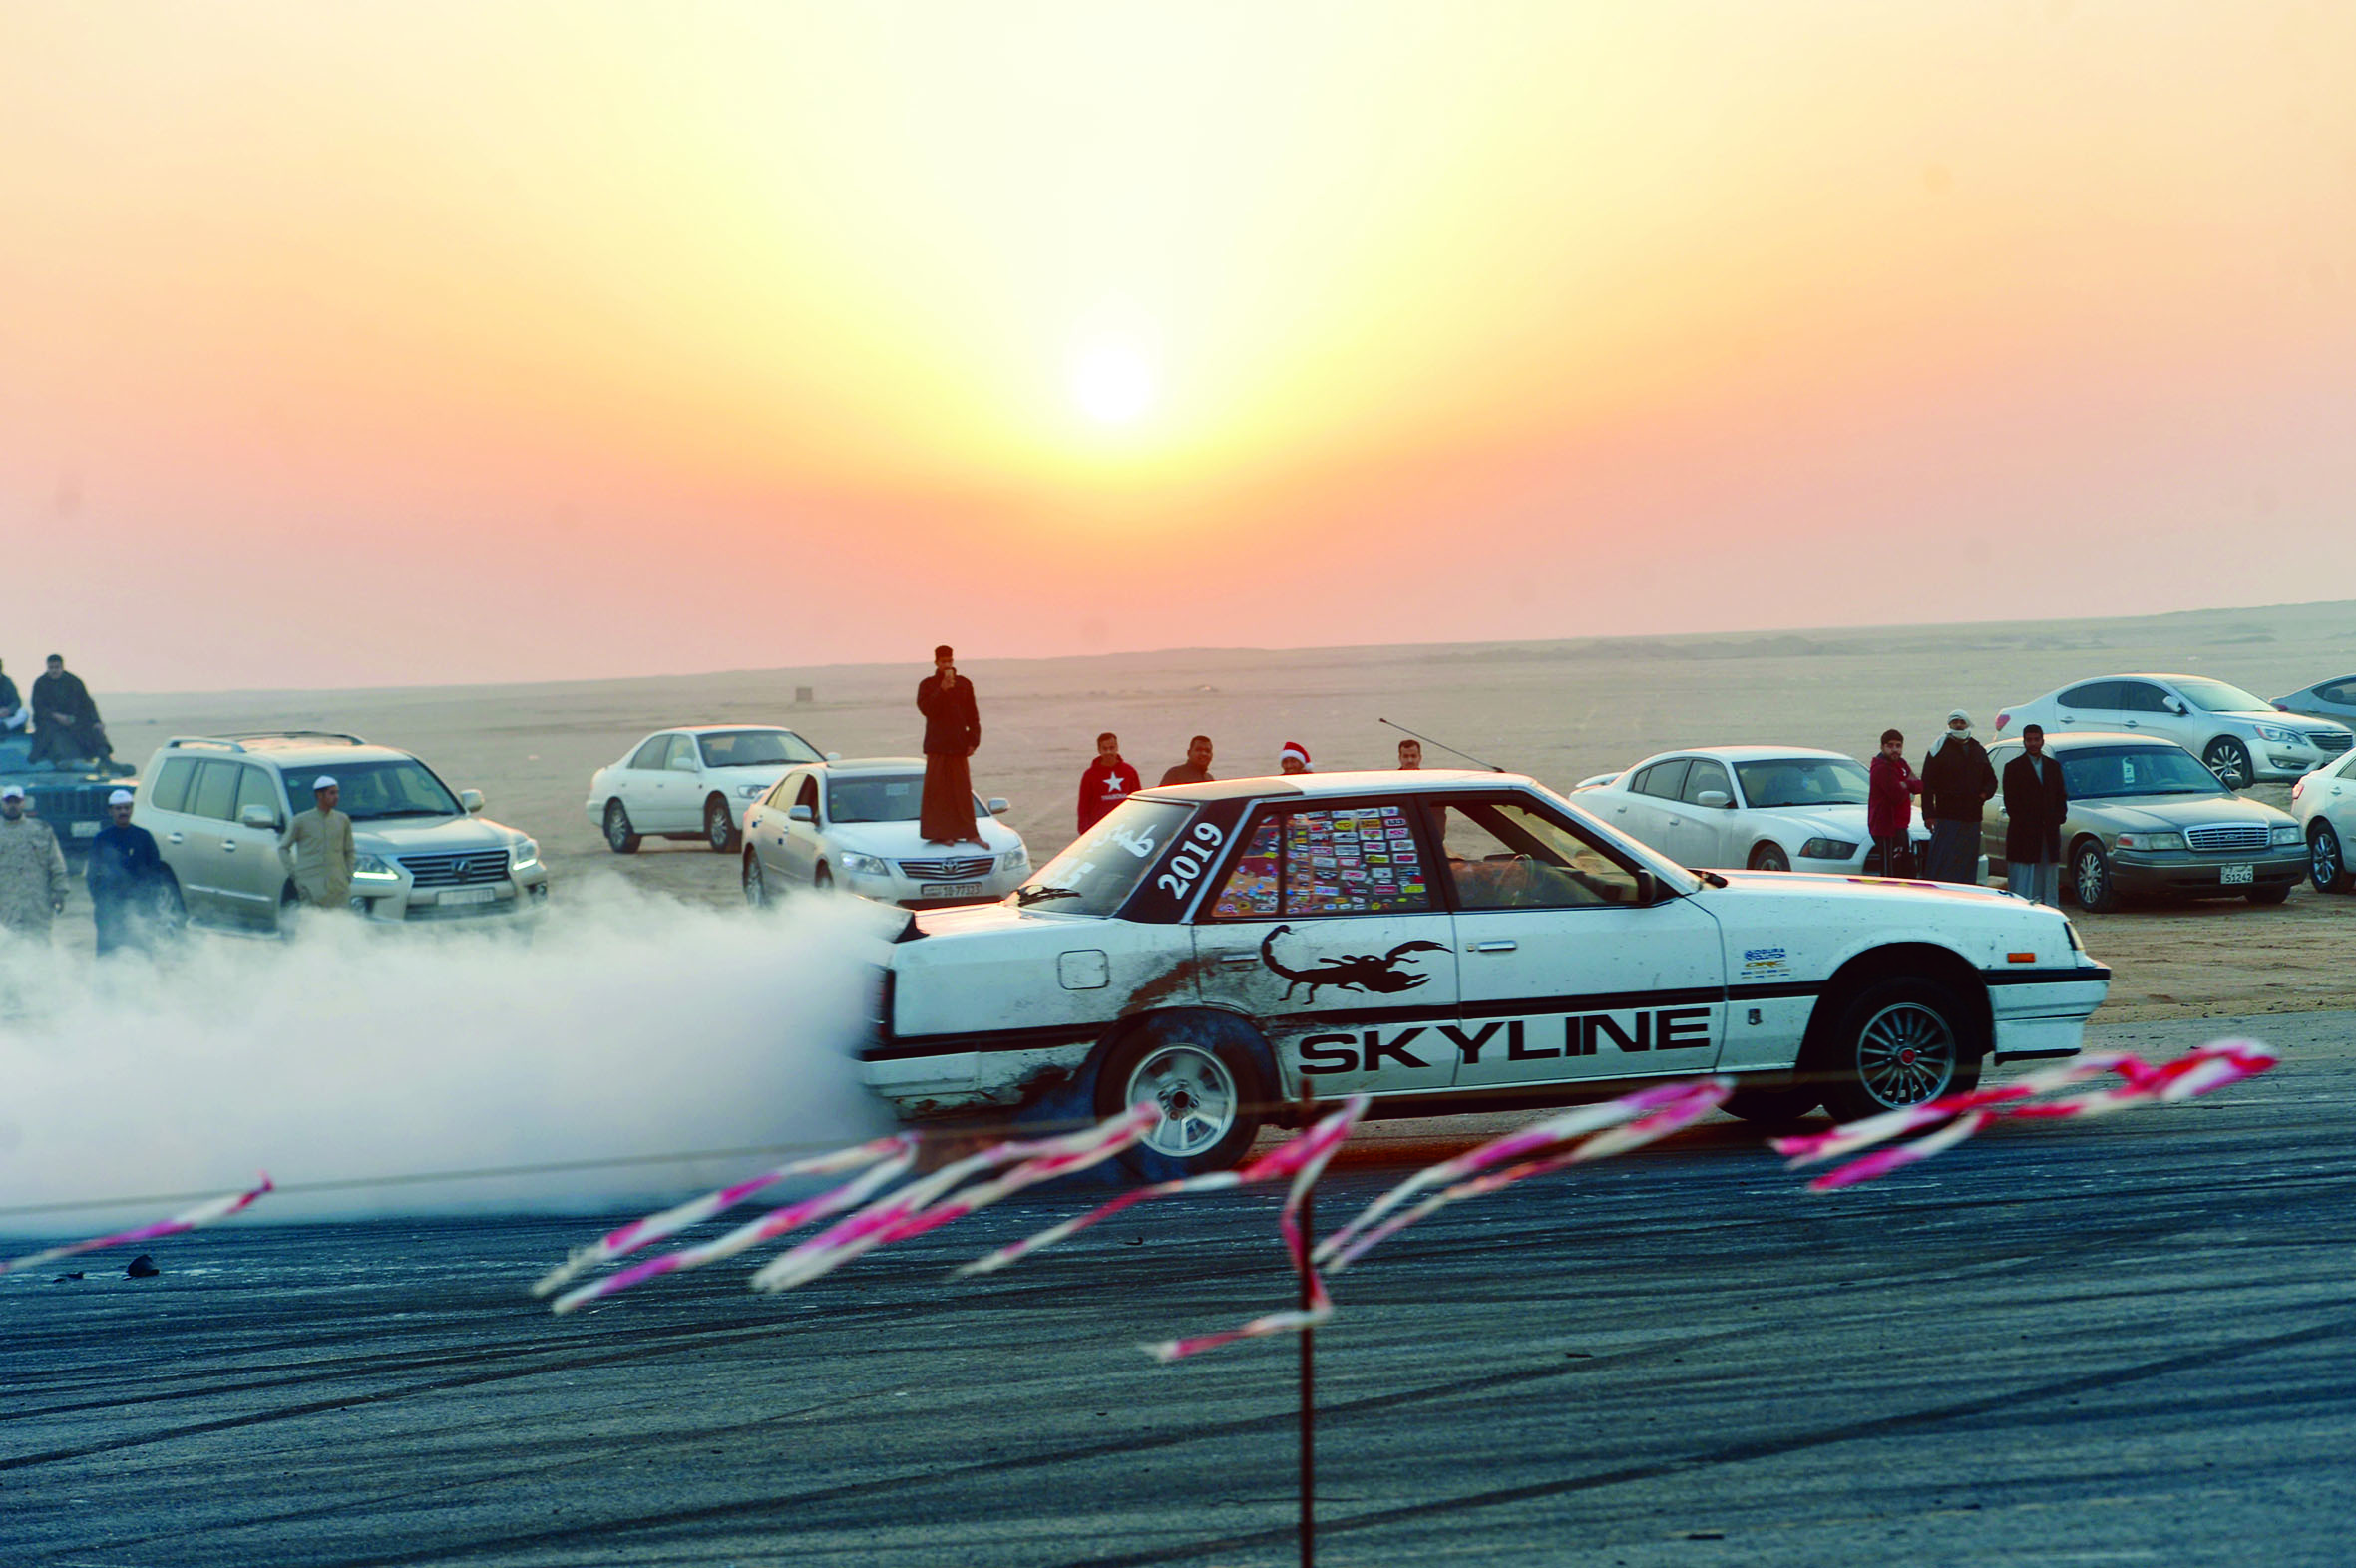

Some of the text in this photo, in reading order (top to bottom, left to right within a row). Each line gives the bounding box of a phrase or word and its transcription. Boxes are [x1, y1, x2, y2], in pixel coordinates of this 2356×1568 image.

[1157, 822, 1223, 900] 2019
[2225, 873, 2252, 883] 51242
[1299, 1007, 1711, 1075] SKYLINE
